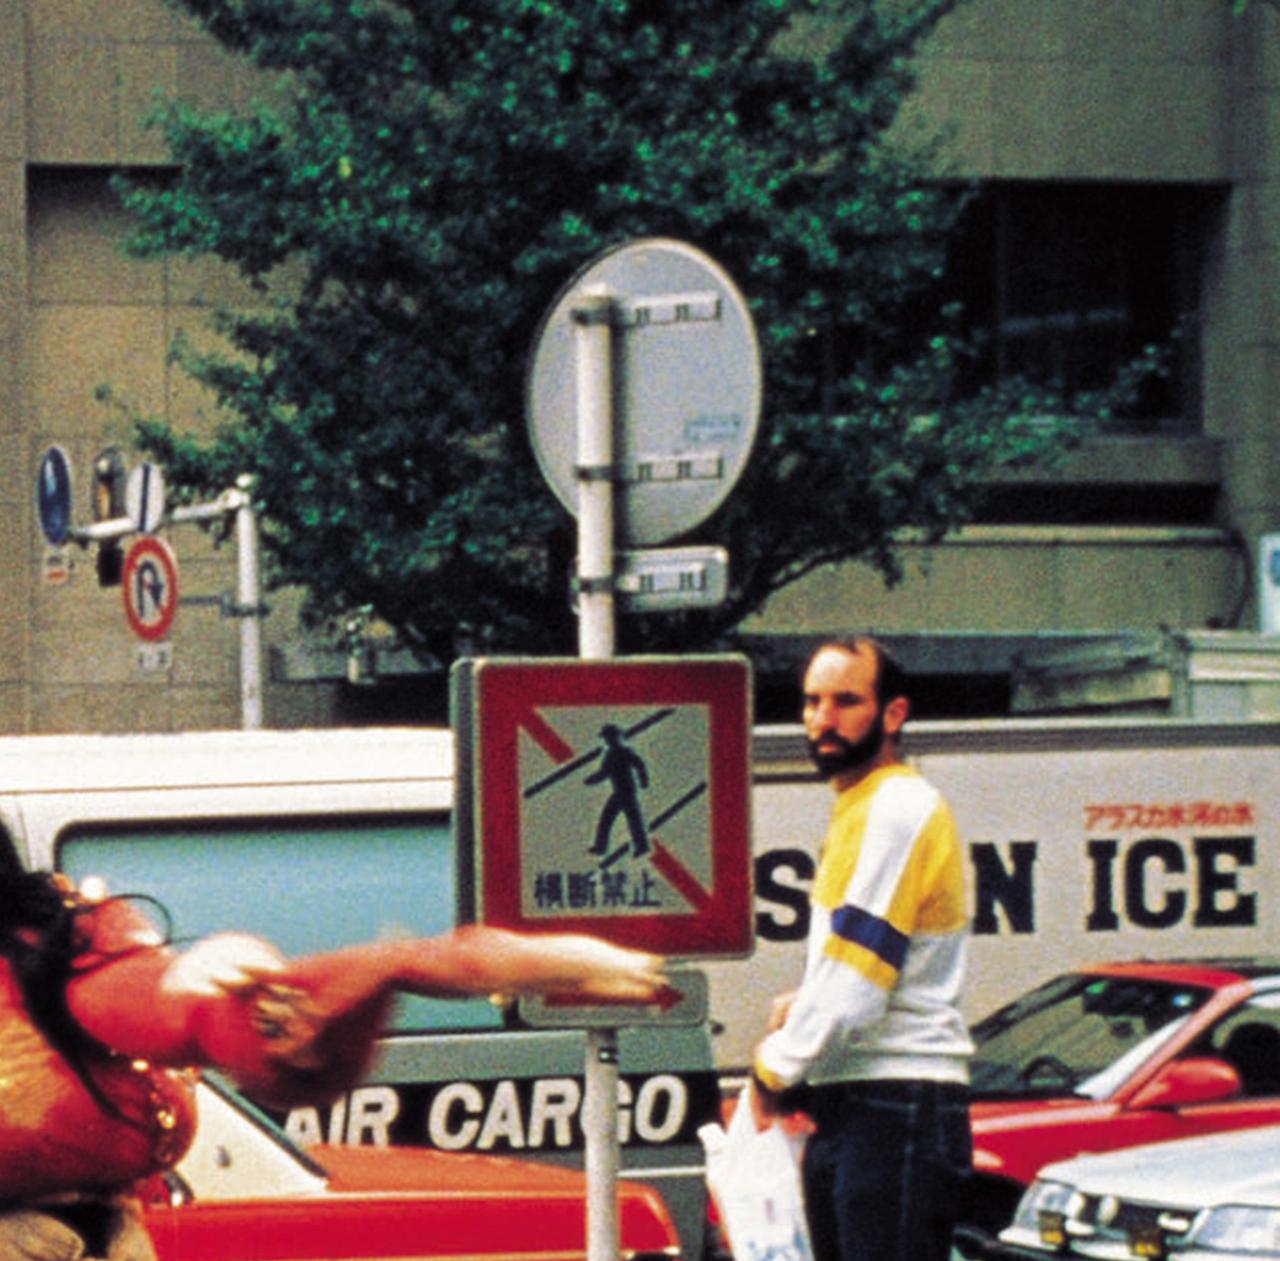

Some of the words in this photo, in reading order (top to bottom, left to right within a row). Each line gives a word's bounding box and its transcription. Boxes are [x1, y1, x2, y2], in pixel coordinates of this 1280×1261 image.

[534, 869, 662, 908] 横断禁止
[1086, 836, 1257, 932] ICE
[284, 1086, 399, 1146] AIR
